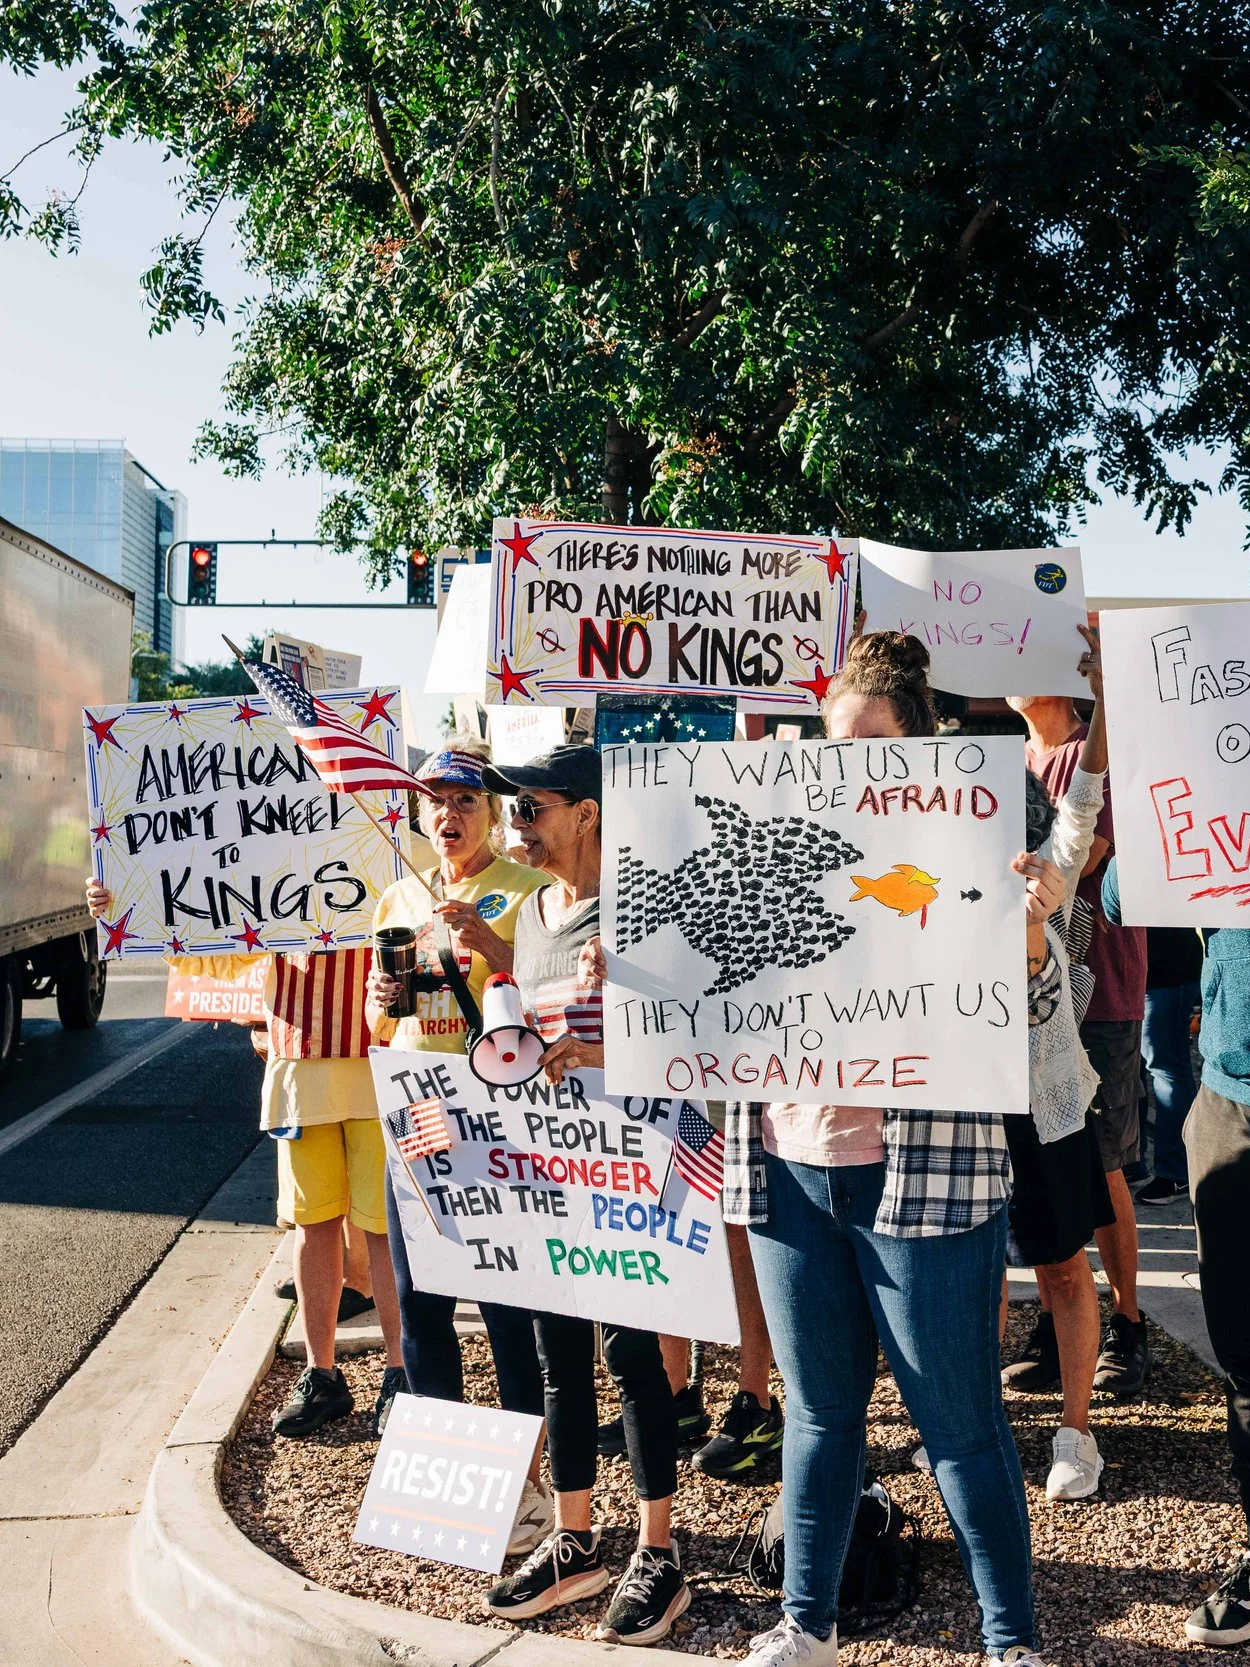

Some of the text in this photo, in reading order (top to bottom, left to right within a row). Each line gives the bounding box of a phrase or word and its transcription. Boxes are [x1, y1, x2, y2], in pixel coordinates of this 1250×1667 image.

[548, 540, 802, 580] THERE'S NOTHING MORE
[524, 579, 825, 623] PRO AMERICAN THAN
[933, 579, 983, 606] NO
[578, 617, 784, 687] NO KINGS
[899, 617, 1032, 655] KINGS!
[602, 742, 987, 788] THEY WANT US TO
[118, 791, 356, 856] DON'T KNEEL
[804, 783, 1000, 820] BE AFRAID
[211, 842, 241, 869] TO
[160, 860, 368, 931] KINGS
[248, 967, 265, 989] AS
[615, 981, 1011, 1038] THEY DON'T WANT US
[778, 1023, 824, 1058] TO
[390, 1063, 459, 1104] THE
[622, 1094, 673, 1126] OF
[665, 1052, 931, 1092] ORGANIZE
[446, 1107, 645, 1159] THE PEOPLE
[425, 1147, 661, 1197] IS STRONGER
[426, 1184, 713, 1255] THEN THE PEOPLE
[466, 1237, 671, 1286] IN POWER
[379, 1449, 514, 1514] RESIST!
